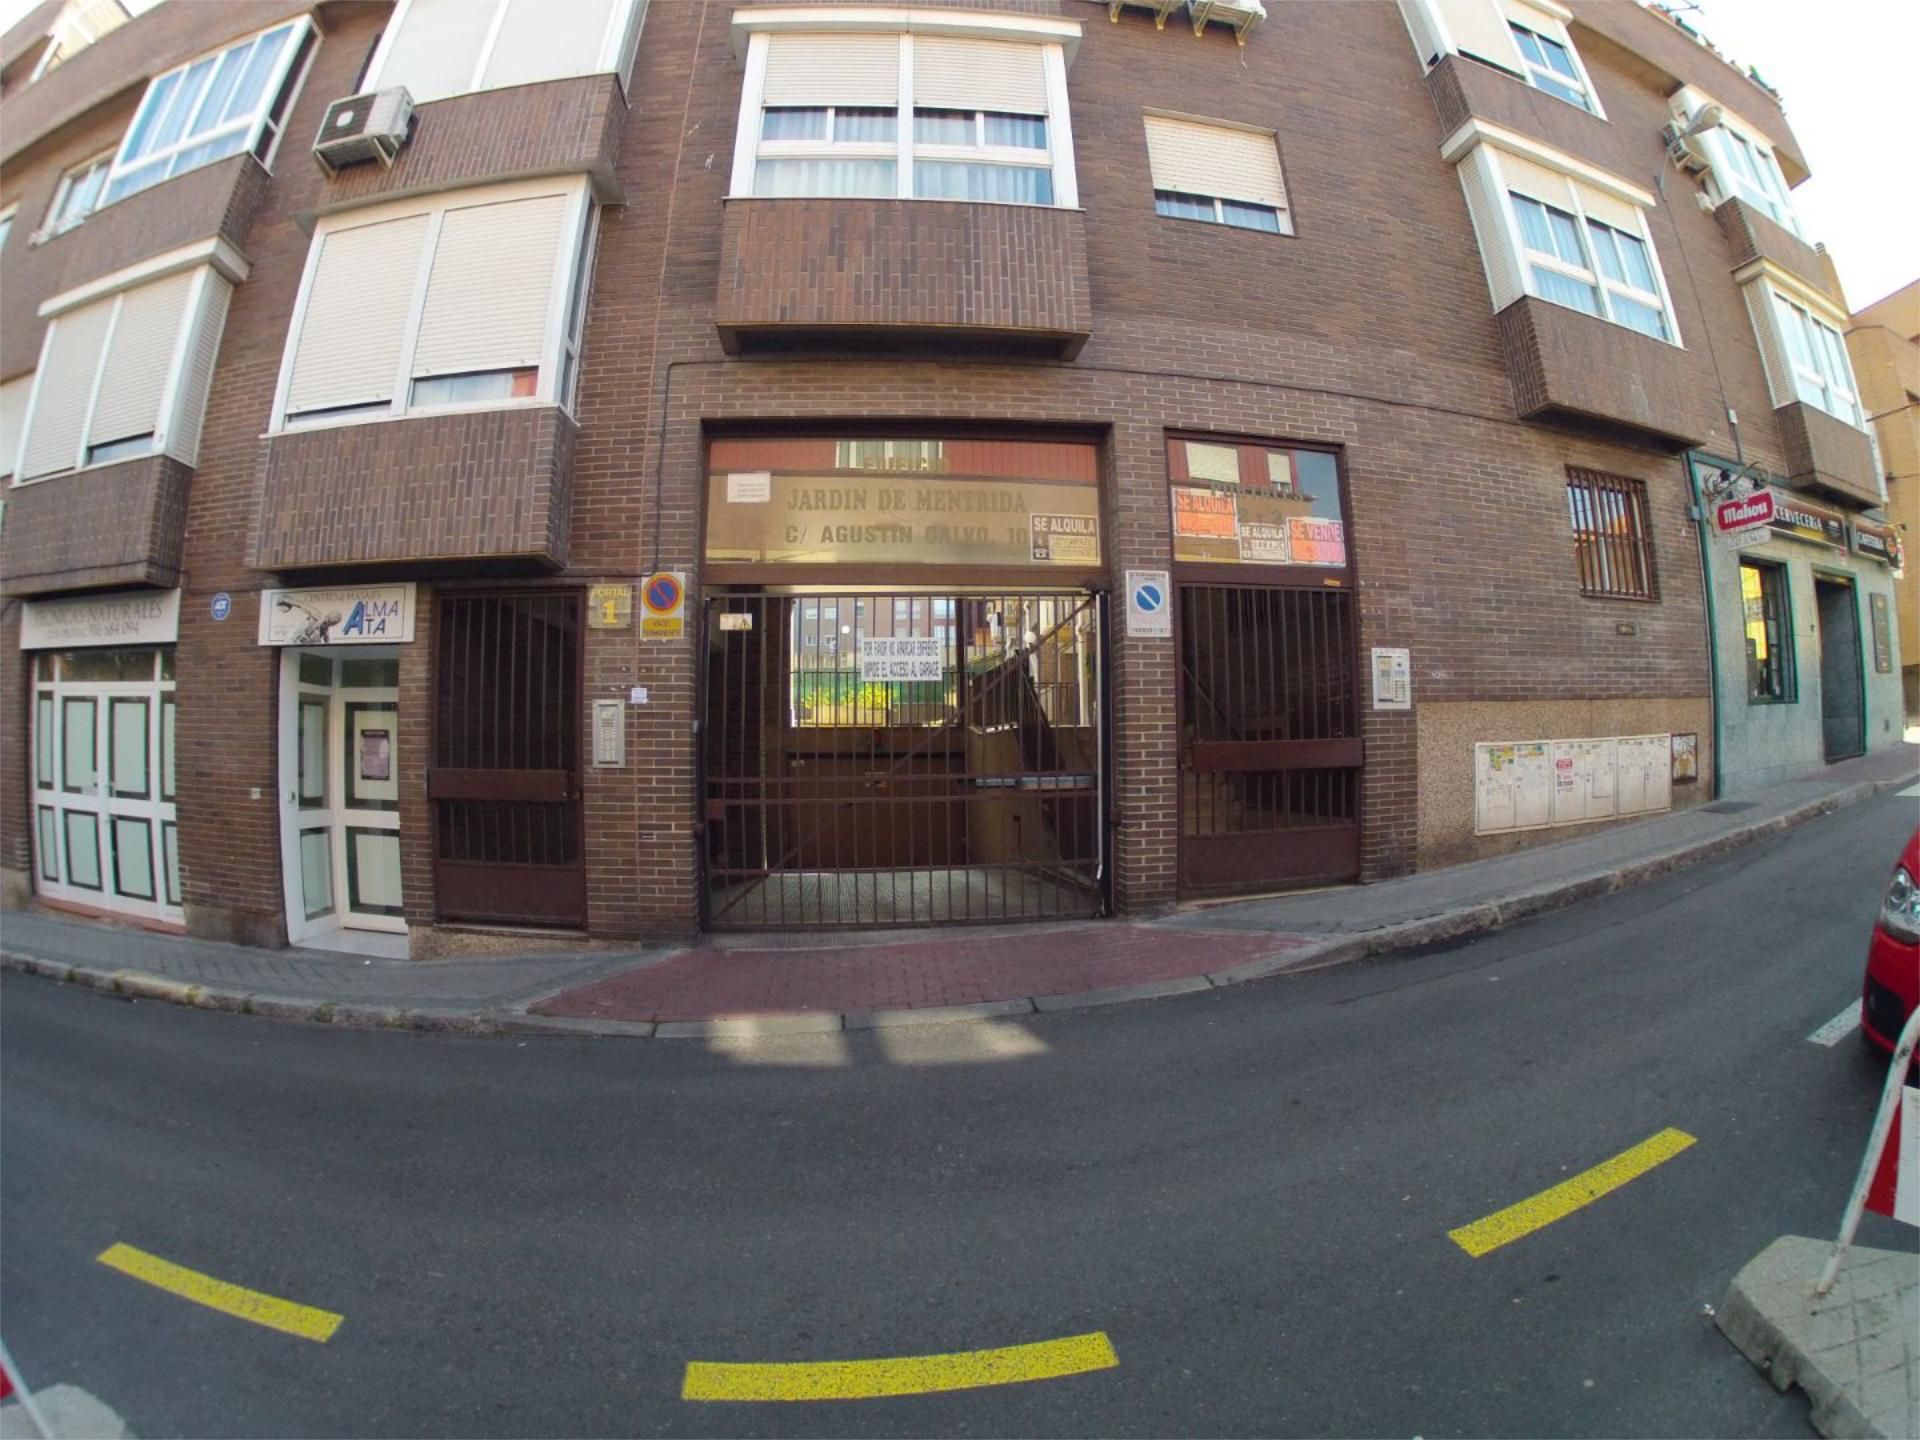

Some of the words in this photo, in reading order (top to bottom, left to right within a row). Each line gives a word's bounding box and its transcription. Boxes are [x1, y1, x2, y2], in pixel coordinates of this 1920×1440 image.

[787, 487, 868, 512] JARDIN
[877, 489, 906, 512] DE
[916, 489, 1029, 514] MENTRIDA
[1178, 495, 1191, 512] SE
[1192, 495, 1233, 515] ALQUILA
[1723, 502, 1769, 524] Mahou
[784, 525, 808, 545] C/
[1034, 517, 1048, 532] SE
[1050, 518, 1096, 534] ALQUILA
[1240, 525, 1251, 537] SE
[1252, 526, 1284, 539] ALQUILA
[1291, 522, 1306, 540] SE
[1306, 523, 1342, 542] VENDE
[602, 600, 618, 624] 1
